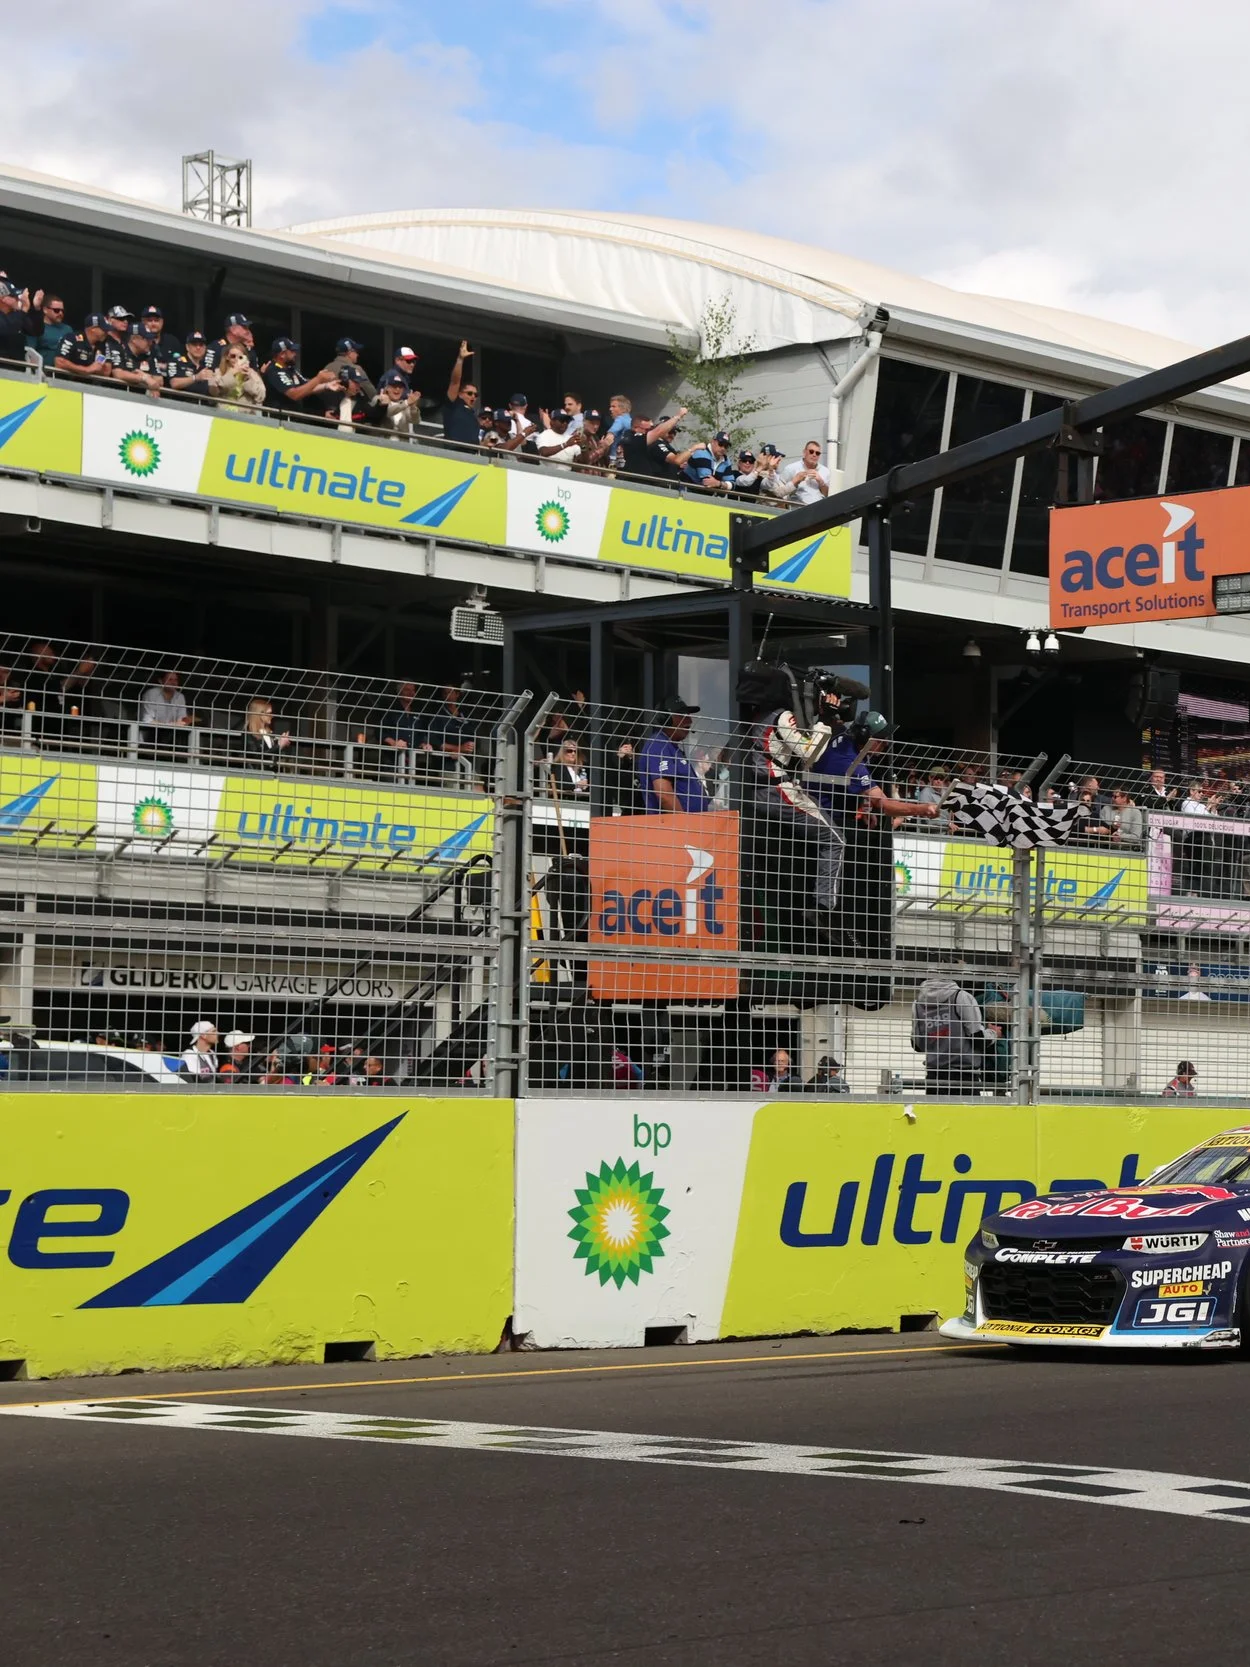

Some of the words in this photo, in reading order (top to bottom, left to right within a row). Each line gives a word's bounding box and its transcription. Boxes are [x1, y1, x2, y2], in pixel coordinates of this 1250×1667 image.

[145, 414, 163, 430] bp
[225, 448, 407, 508] ultimate
[557, 486, 572, 501] bp
[621, 514, 728, 560] ultima
[1060, 503, 1206, 594] aceit
[1060, 600, 1131, 618] Transport
[1135, 593, 1206, 612] Solutions
[157, 780, 176, 795] bp
[237, 803, 417, 852] ultimate
[598, 846, 725, 936] aceit
[954, 864, 1079, 903] ultite
[109, 964, 229, 991] GLIDEROL
[232, 974, 318, 996] GARAGE
[325, 978, 394, 999] DOORS
[633, 1114, 673, 1156] bp
[779, 1153, 1143, 1248] ultim
[1078, 1196, 1216, 1220] Bull
[0, 1189, 130, 1269] e
[1147, 1235, 1200, 1249] WÜRTH
[1132, 1260, 1232, 1289] SUPERCHEAP
[1163, 1284, 1198, 1295] AUTO
[978, 1322, 1028, 1332] NATIONAL
[1032, 1326, 1100, 1336] STORAGE
[1140, 1302, 1210, 1324] JGI
